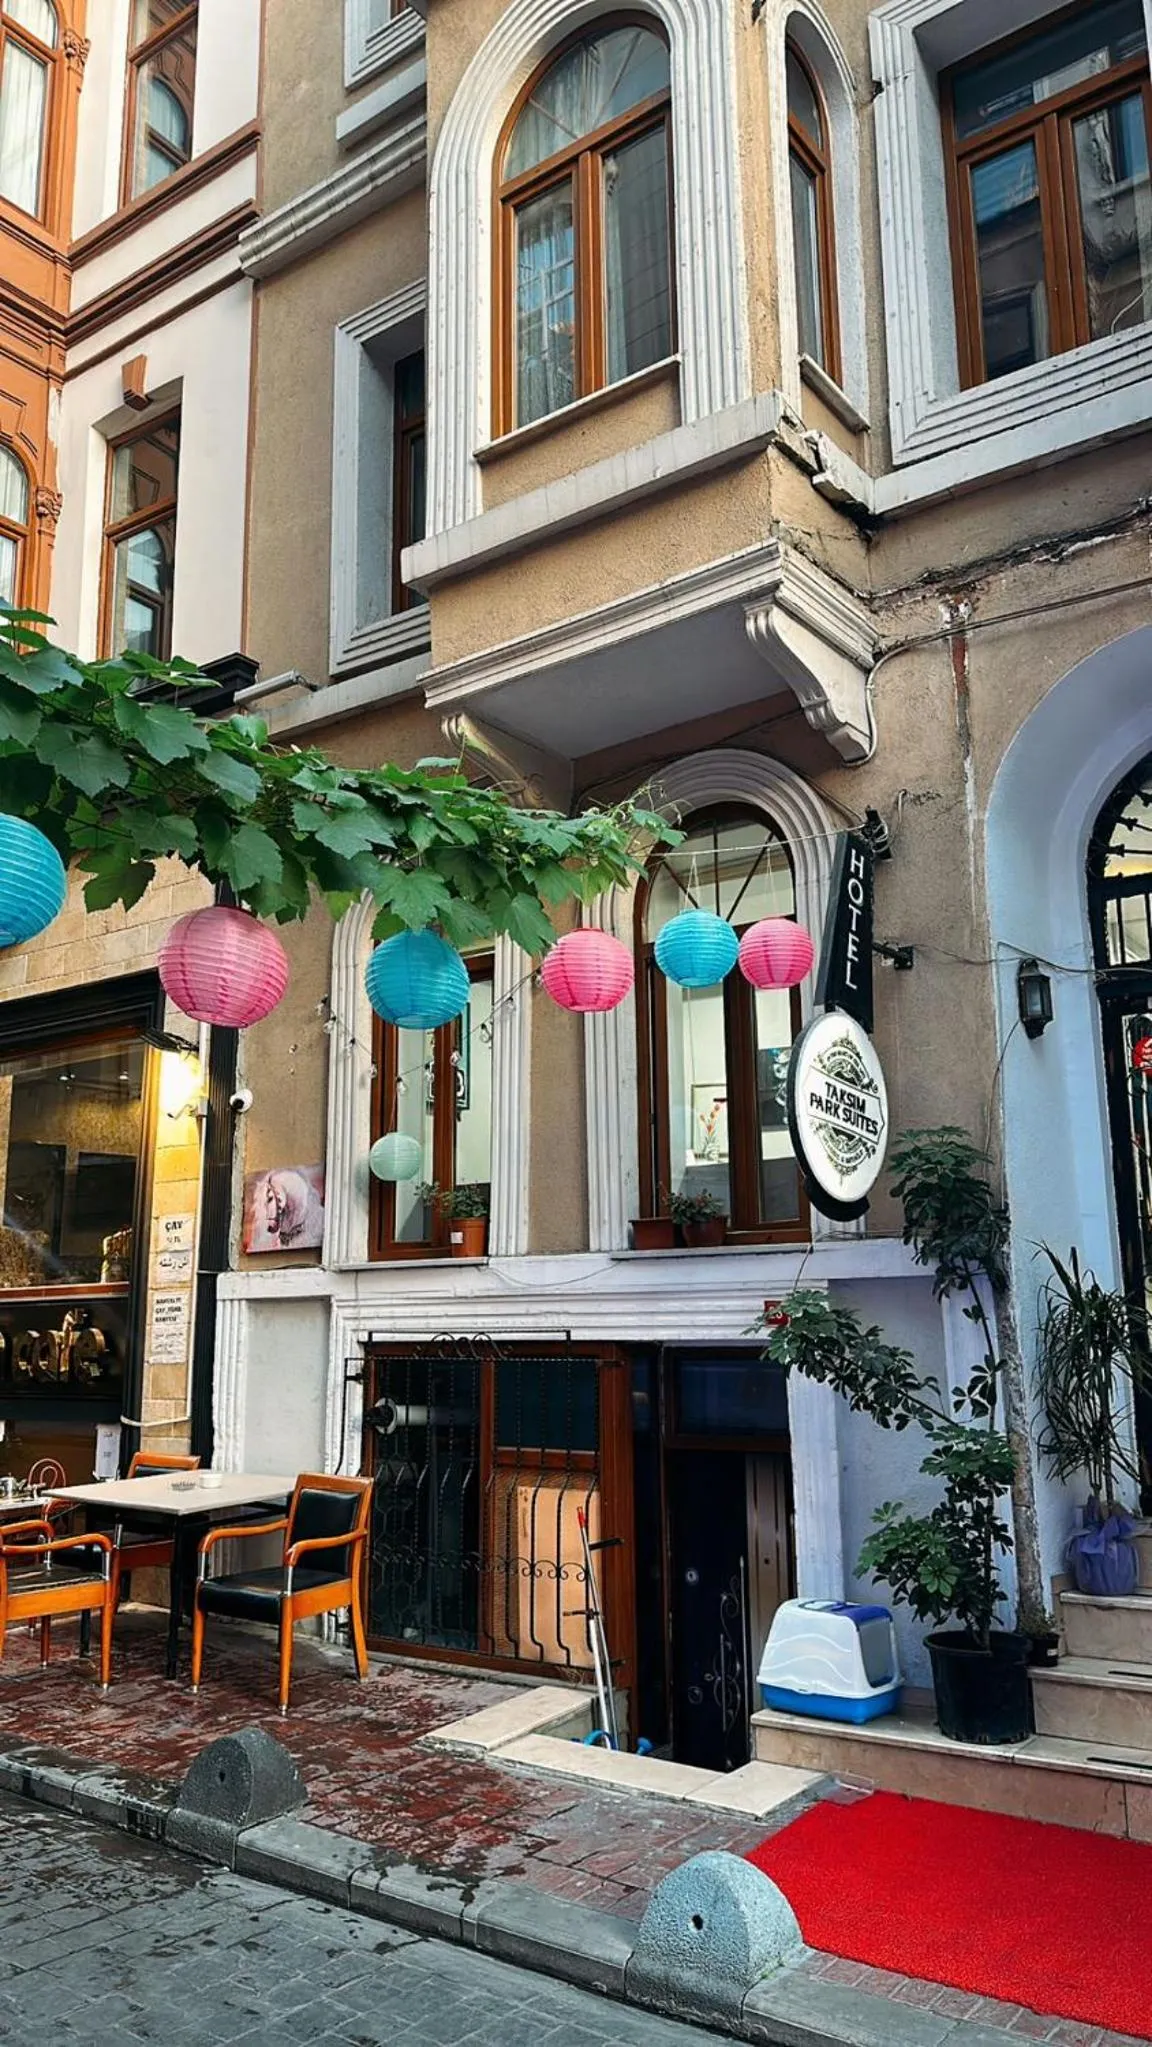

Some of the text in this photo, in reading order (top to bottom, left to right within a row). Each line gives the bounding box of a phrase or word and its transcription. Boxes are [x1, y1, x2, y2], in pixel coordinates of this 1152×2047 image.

[846, 849, 864, 989] HOTEL
[810, 1092, 878, 1136] PARK SUITES
[825, 1081, 866, 1114] TAKSIM
